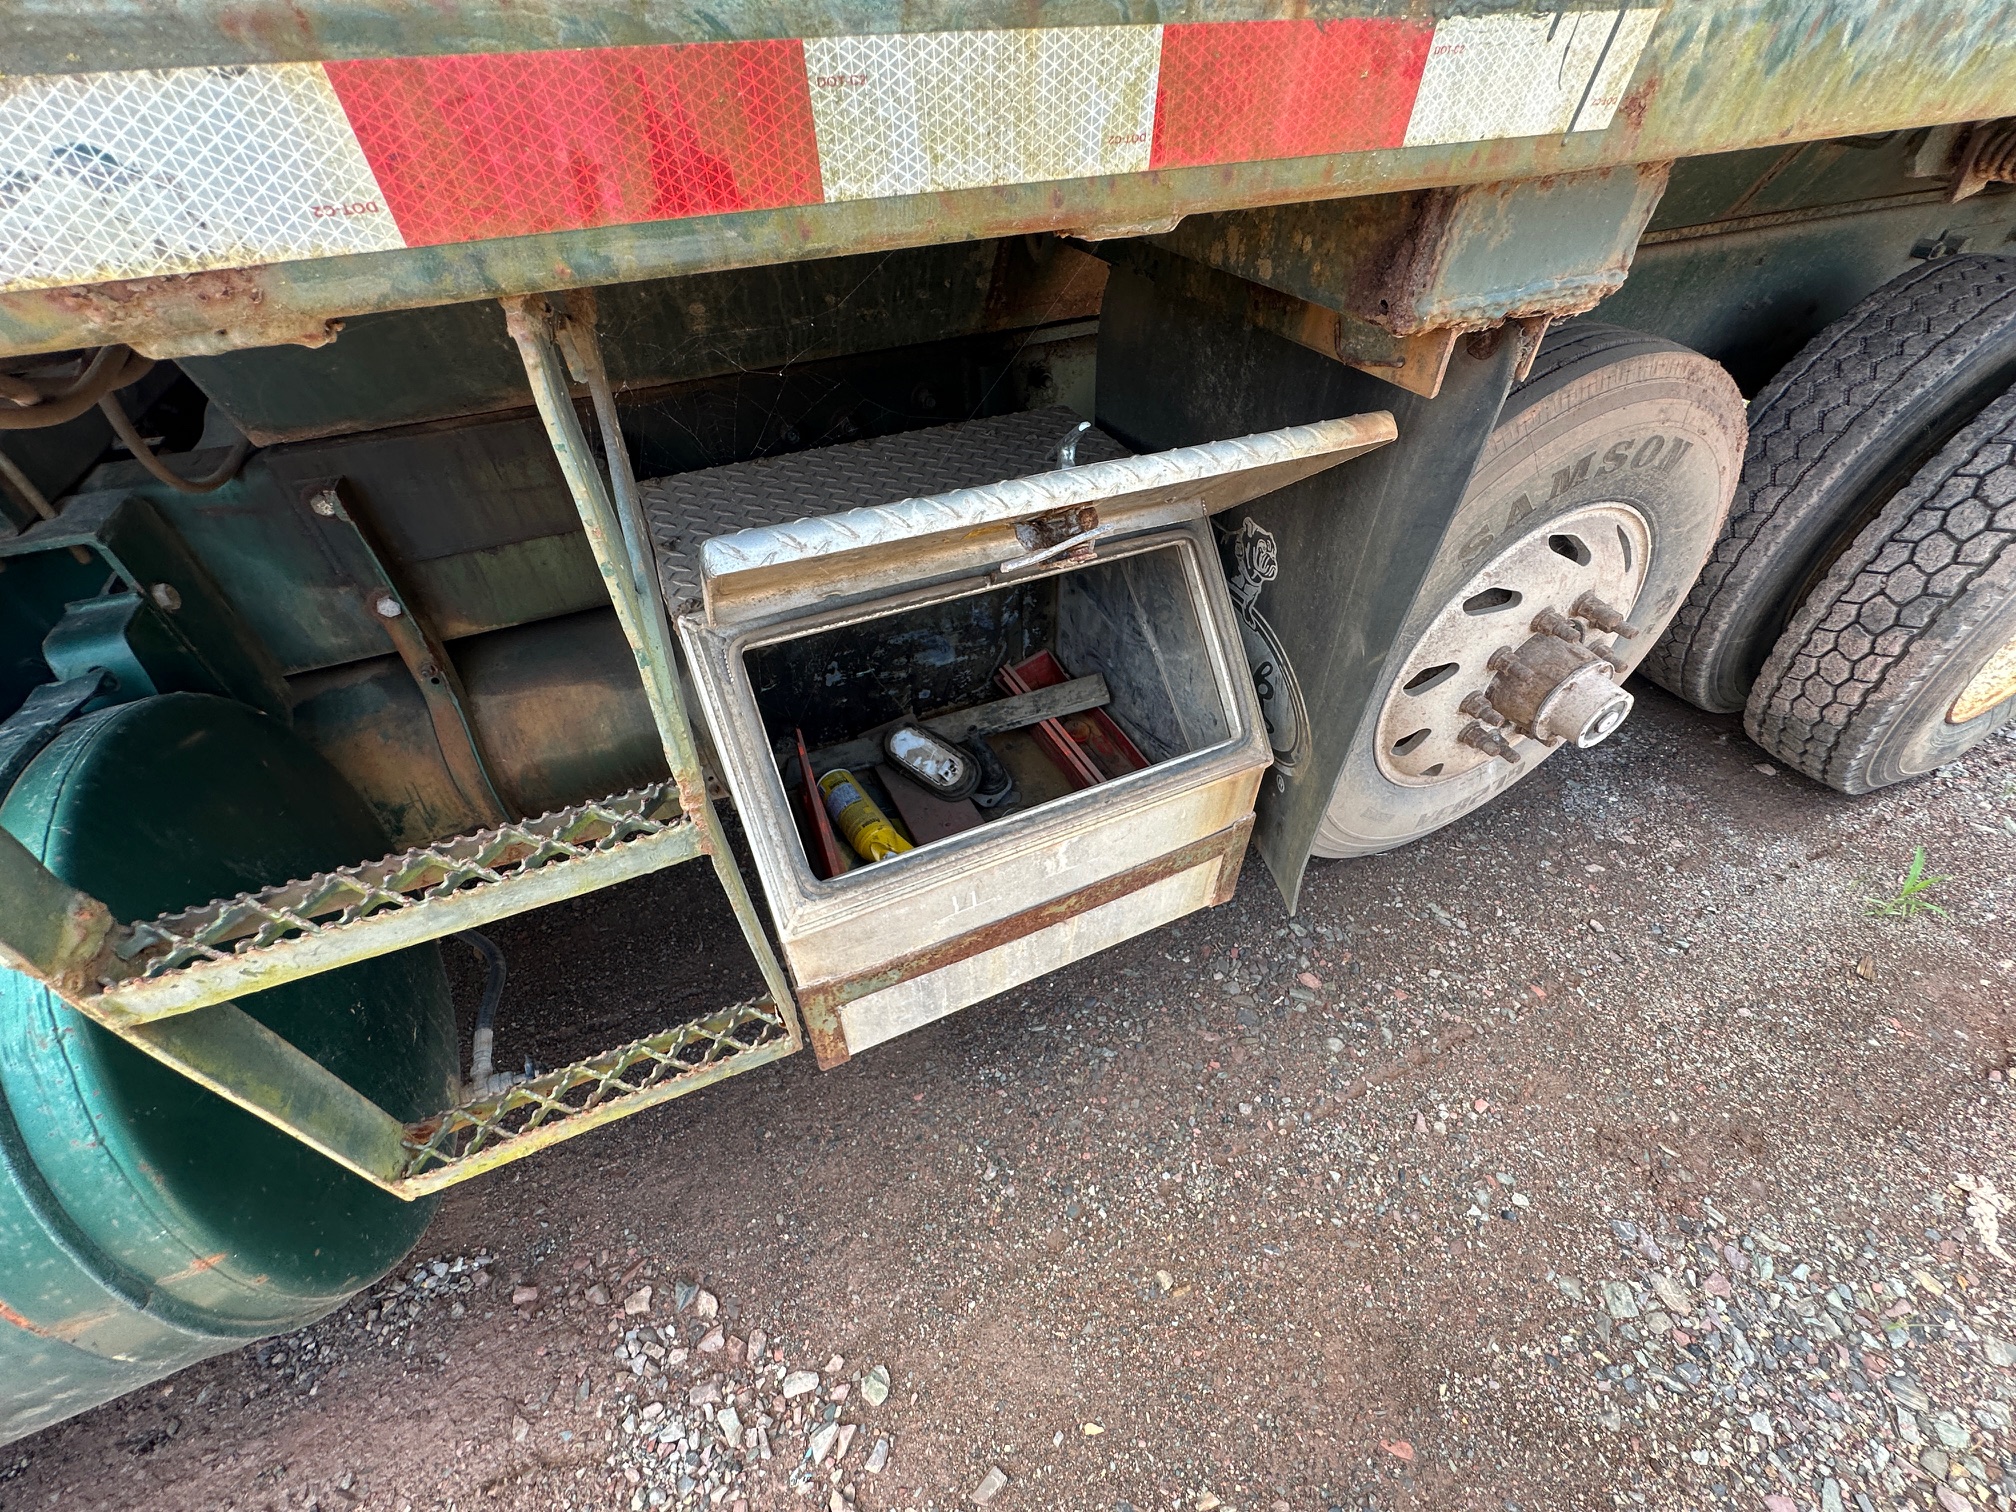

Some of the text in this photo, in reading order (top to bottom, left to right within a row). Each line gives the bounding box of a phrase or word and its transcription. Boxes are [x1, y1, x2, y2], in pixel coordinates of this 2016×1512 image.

[1434, 44, 1466, 55] DOT-C2
[816, 74, 868, 88] DOT-C2
[1108, 132, 1147, 144] DOT-C2
[312, 200, 379, 218] DOT-C2
[1457, 434, 1694, 570] SAMSON
